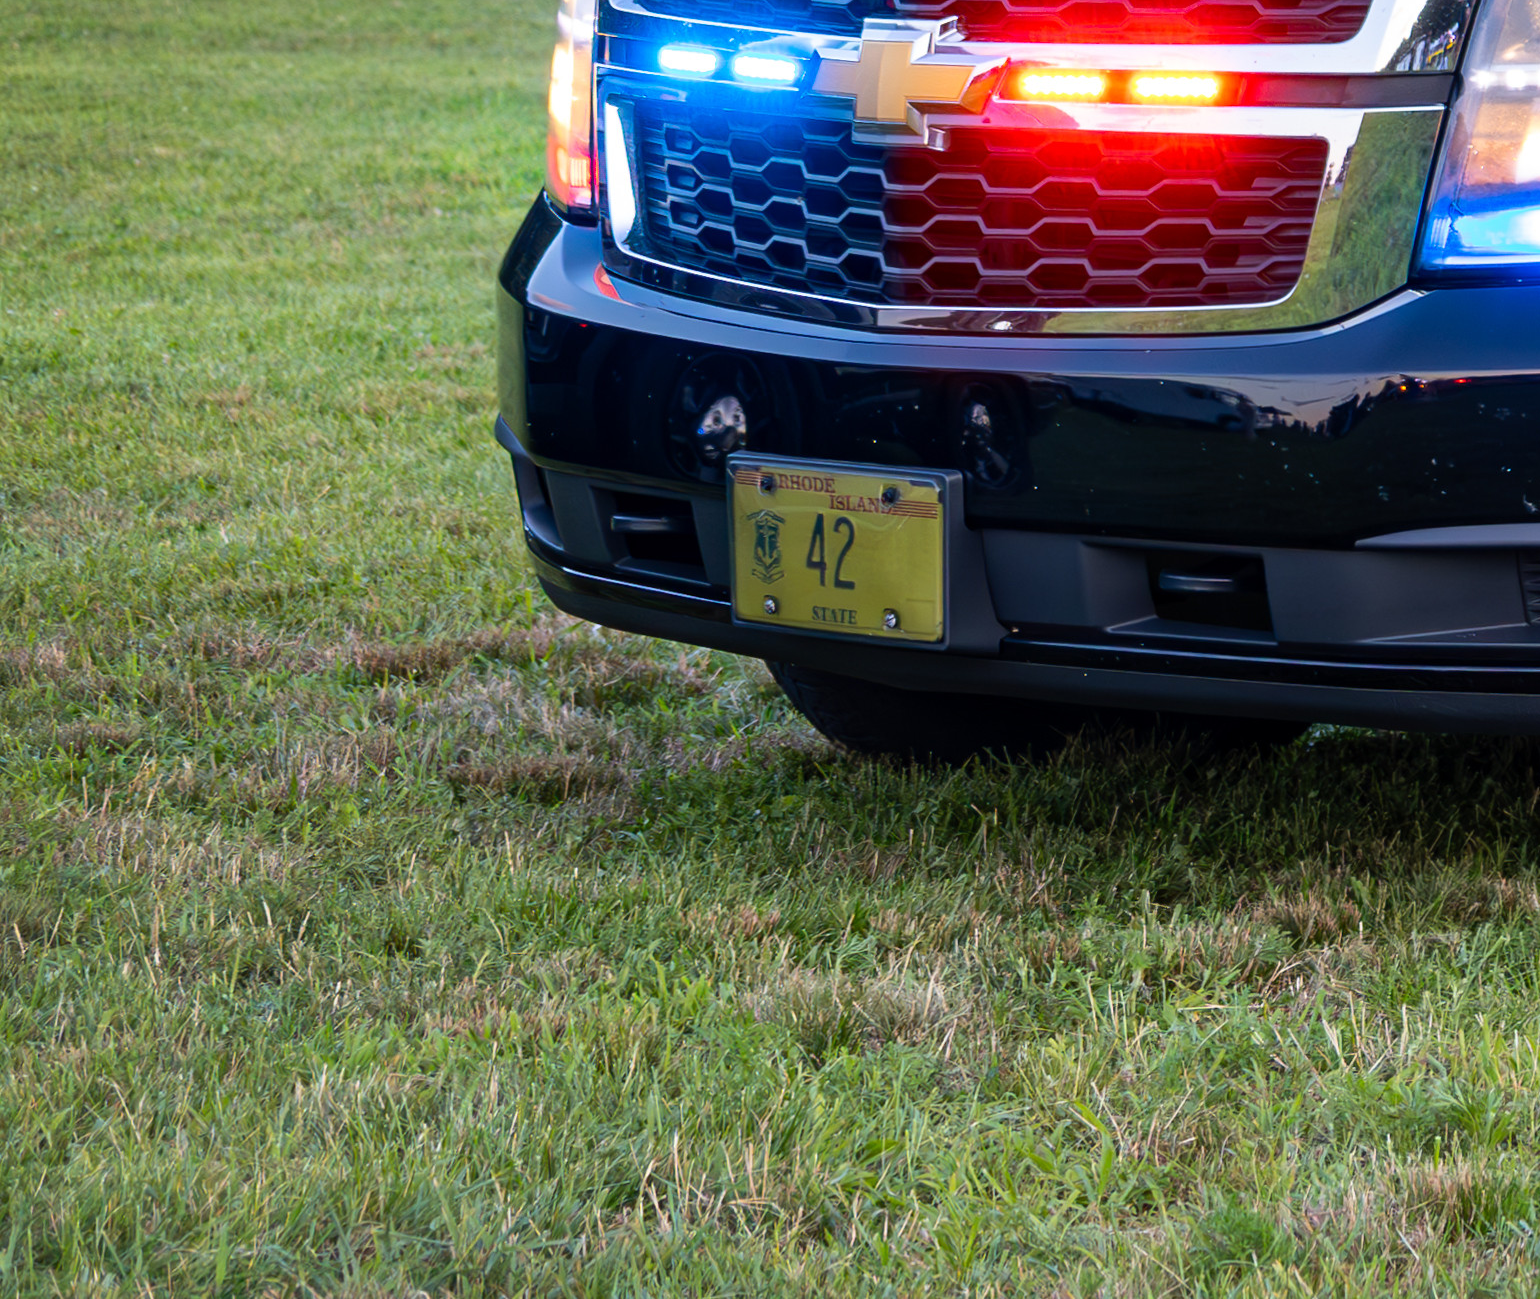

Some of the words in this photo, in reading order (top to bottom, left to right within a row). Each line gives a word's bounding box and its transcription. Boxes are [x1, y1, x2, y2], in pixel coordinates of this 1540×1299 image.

[778, 473, 836, 493] RHODE
[806, 513, 856, 590] 42
[811, 605, 858, 625] STATE
